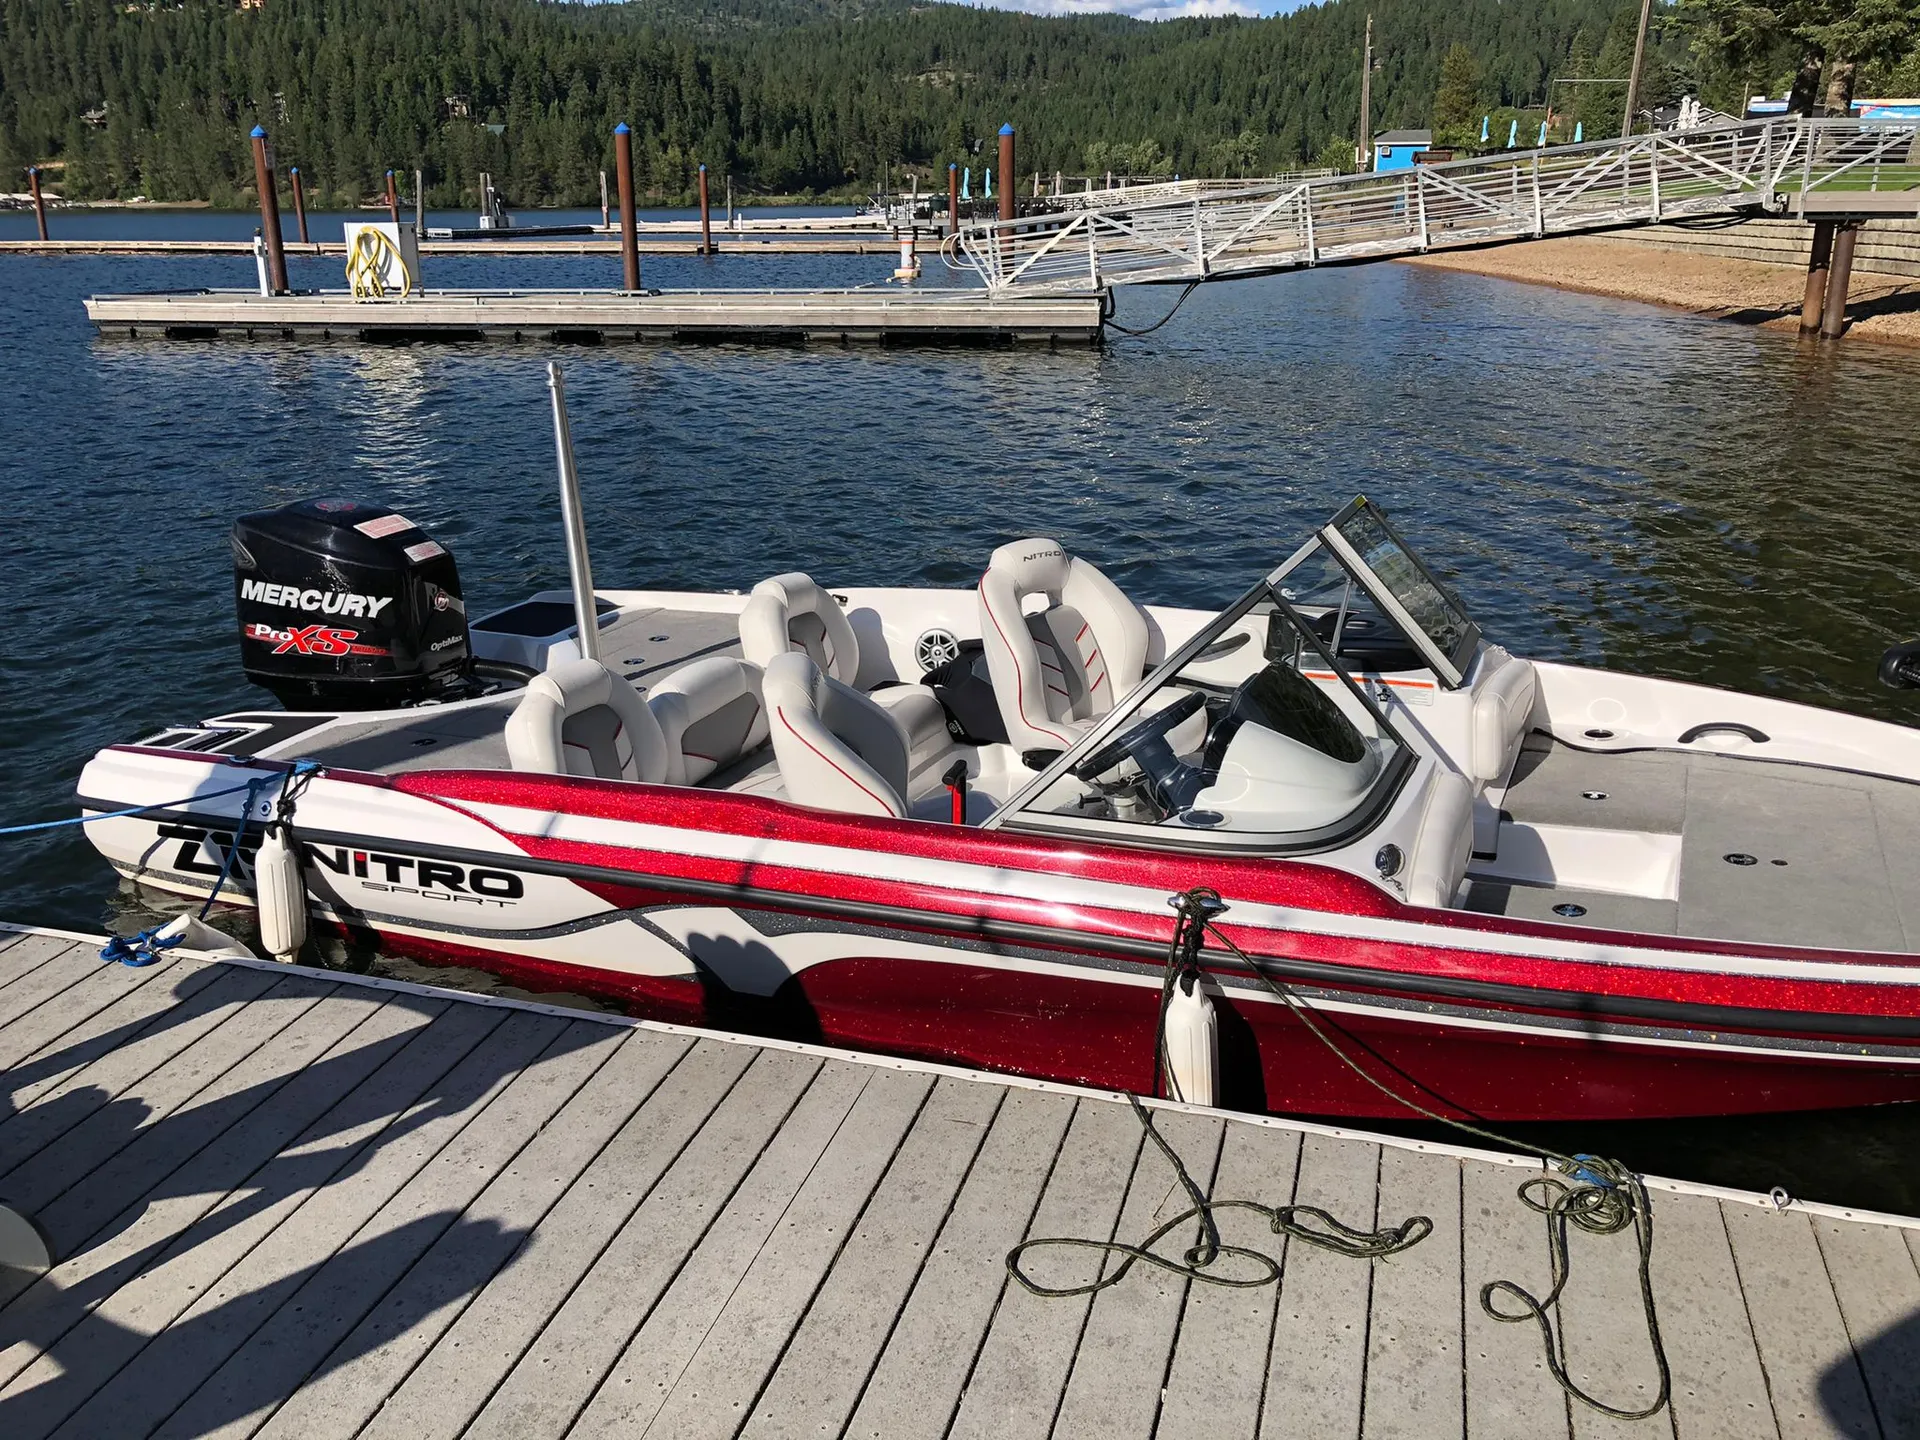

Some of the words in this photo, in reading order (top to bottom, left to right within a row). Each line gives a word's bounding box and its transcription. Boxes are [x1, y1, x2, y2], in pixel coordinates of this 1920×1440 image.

[1023, 550, 1061, 562] NITRO
[241, 578, 393, 618] MERCURY
[430, 634, 463, 651] OptiMax
[302, 842, 525, 899] NITRO
[361, 881, 518, 908] SPORT
